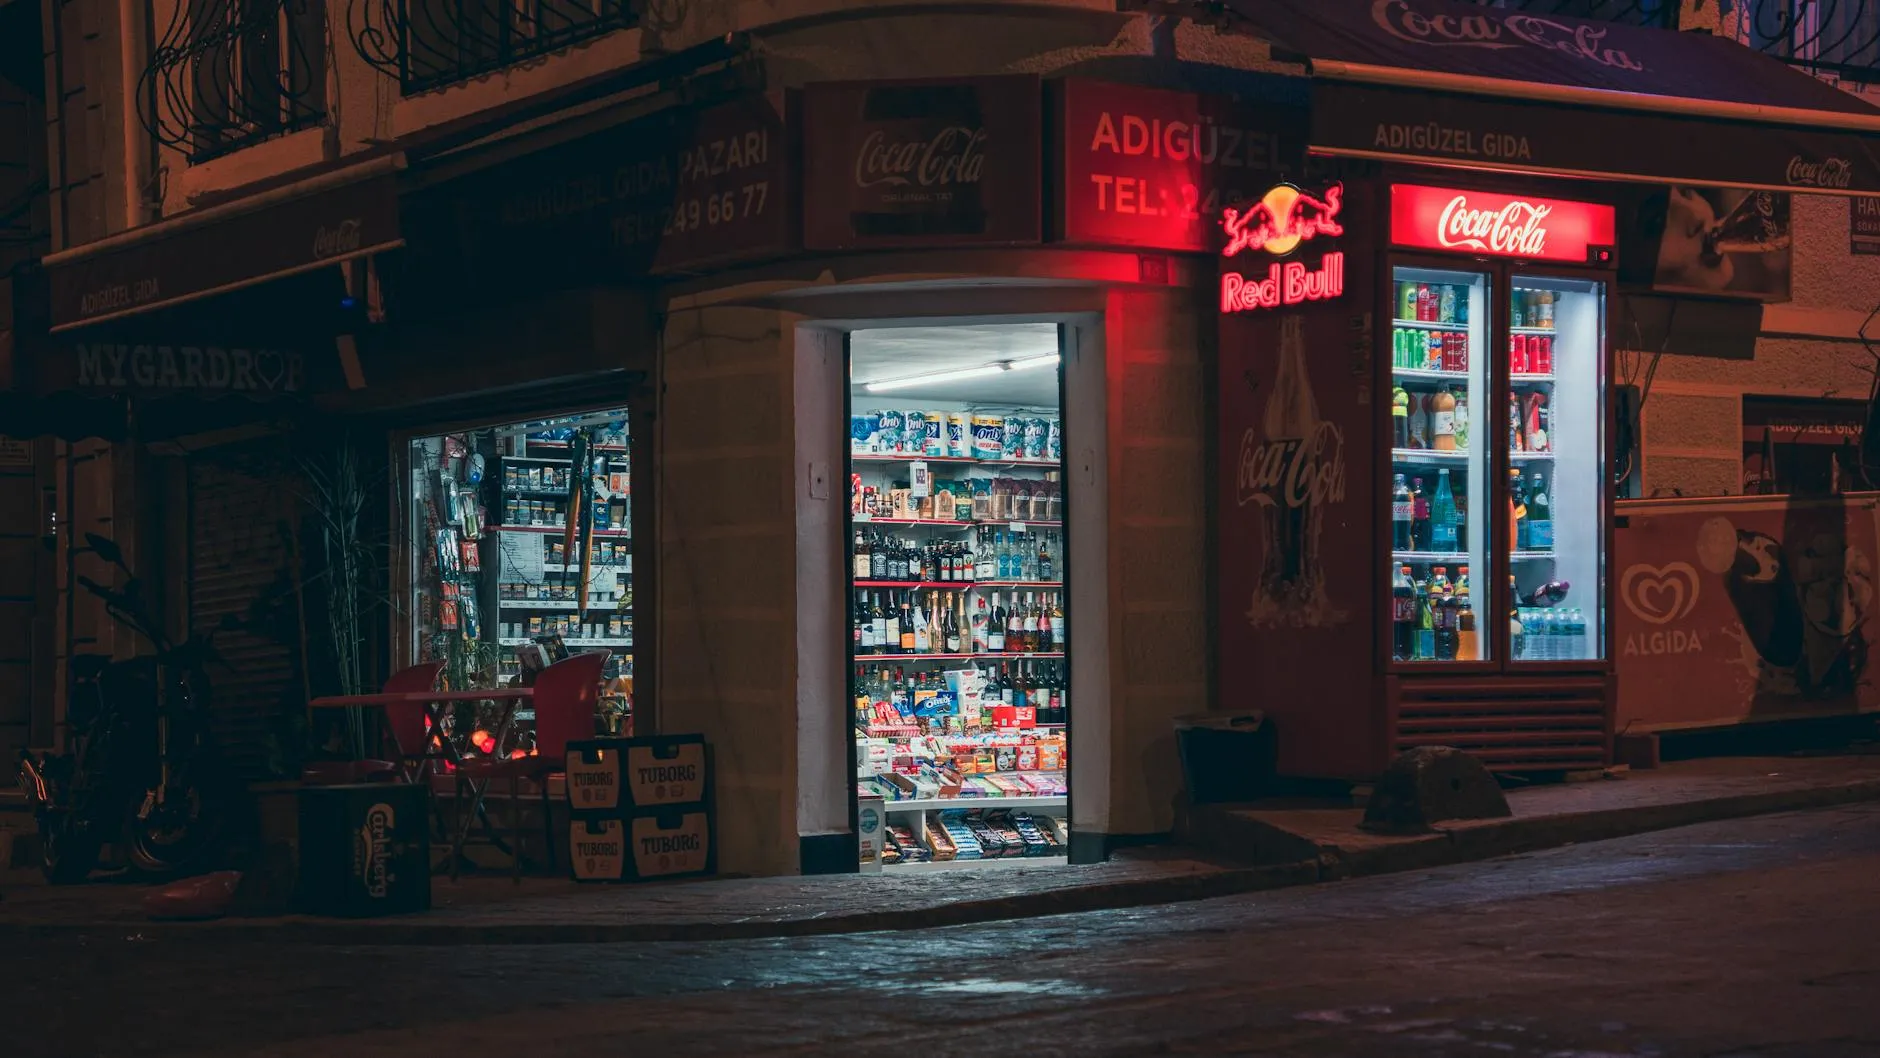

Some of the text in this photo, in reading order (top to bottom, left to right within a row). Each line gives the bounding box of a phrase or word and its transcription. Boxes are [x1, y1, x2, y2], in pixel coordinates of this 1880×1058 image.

[855, 126, 988, 188] Coca-Cola
[1091, 111, 1290, 173] ADIGÜZEL
[1374, 121, 1532, 160] ADIGÜZEL GIDA
[614, 155, 671, 201] GIDA
[678, 127, 768, 185] PAZARI
[1786, 155, 1852, 187] Coca-Cola
[662, 199, 700, 236] 249
[707, 190, 735, 226] 66
[742, 182, 768, 218] 77
[1091, 174, 1167, 217] TEL:
[313, 218, 362, 259] Coca-Cola
[1437, 194, 1553, 255] Coca-Cola
[133, 277, 160, 303] GIDA
[1220, 251, 1344, 313] Red Bull
[879, 416, 900, 428] Only
[977, 427, 1001, 441] Only
[1237, 420, 1345, 508] Coca-Cola
[573, 771, 613, 787] TUBORG
[638, 764, 696, 784] TUBORG
[361, 803, 394, 898] Carlsberg
[576, 842, 618, 857] TUBORG
[641, 833, 700, 855] TUBORG
